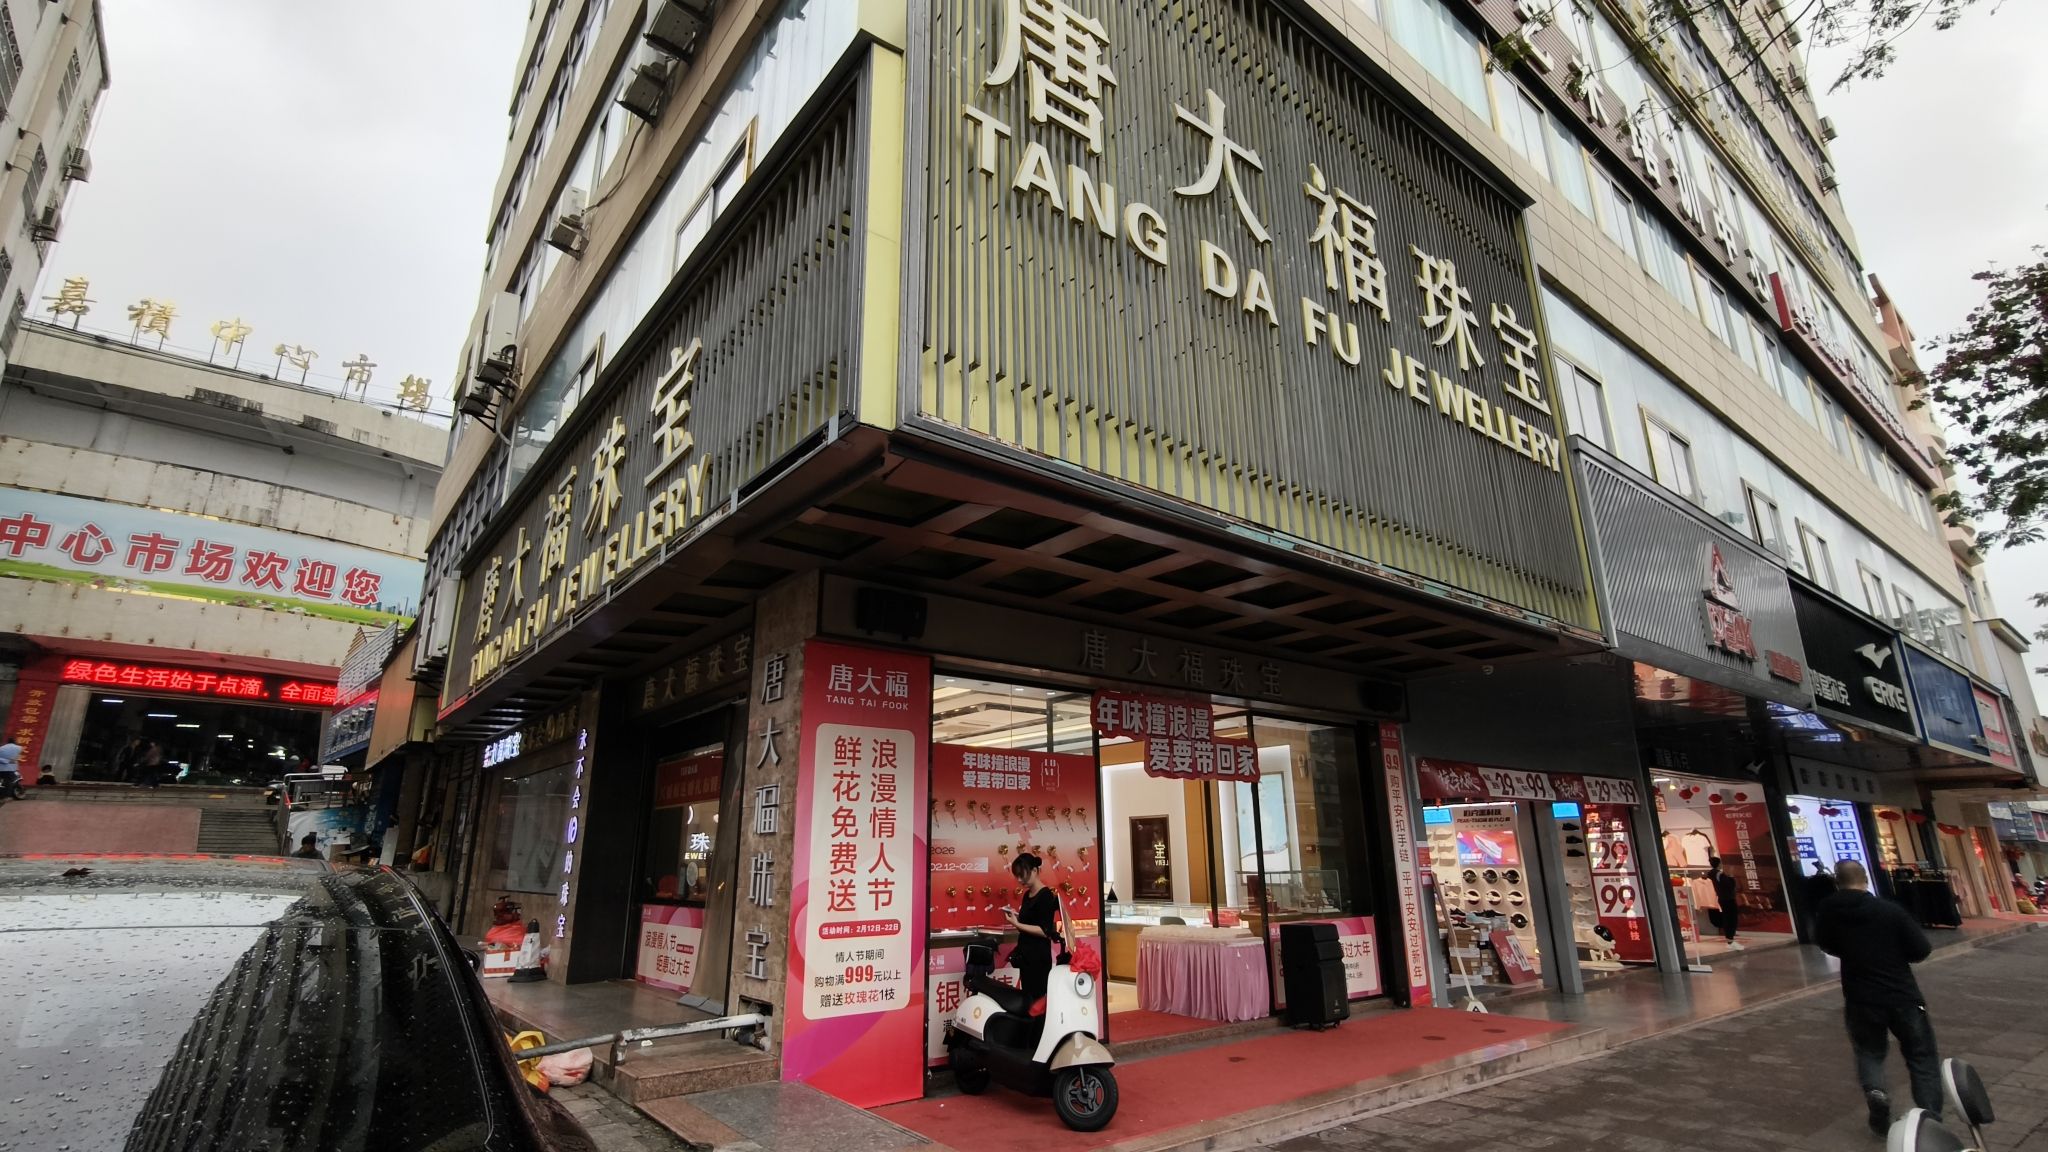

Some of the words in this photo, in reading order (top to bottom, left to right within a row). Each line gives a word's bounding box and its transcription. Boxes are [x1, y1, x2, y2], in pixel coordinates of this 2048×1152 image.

[982, 0, 1552, 415] 唐大福珠宝
[963, 104, 1168, 267] TANG
[1201, 239, 1279, 328] DA
[1302, 296, 1361, 367] FU
[1383, 348, 1561, 472] JEWELLERY
[472, 336, 702, 645] 唐大福珠宝
[552, 452, 711, 622] JEWELLERY
[0, 511, 386, 607] 中心市场欢迎您
[827, 663, 909, 699] 唐大福
[1081, 629, 1284, 699] 唐大福珠宝
[826, 694, 855, 705] TANG
[860, 698, 877, 708] TAI
[882, 700, 909, 711] FOOK
[1869, 677, 1908, 713] ERKE
[1096, 698, 1213, 742] 年味撞浪漫
[962, 751, 1031, 773] 年味撞浪漫
[1148, 736, 1258, 777] 爱要带回家
[962, 770, 1031, 791] 爱要带回家
[743, 652, 790, 981] 唐大福珠宝
[827, 735, 862, 913] 鲜花免费送
[868, 738, 898, 912] 浪漫情人节
[931, 846, 955, 855] 2026
[1600, 884, 1636, 914] 99
[814, 964, 902, 988] 购物满999元以上
[835, 948, 885, 963] 情人节期间
[820, 986, 896, 1008] 赠送玫瑰花1枝
